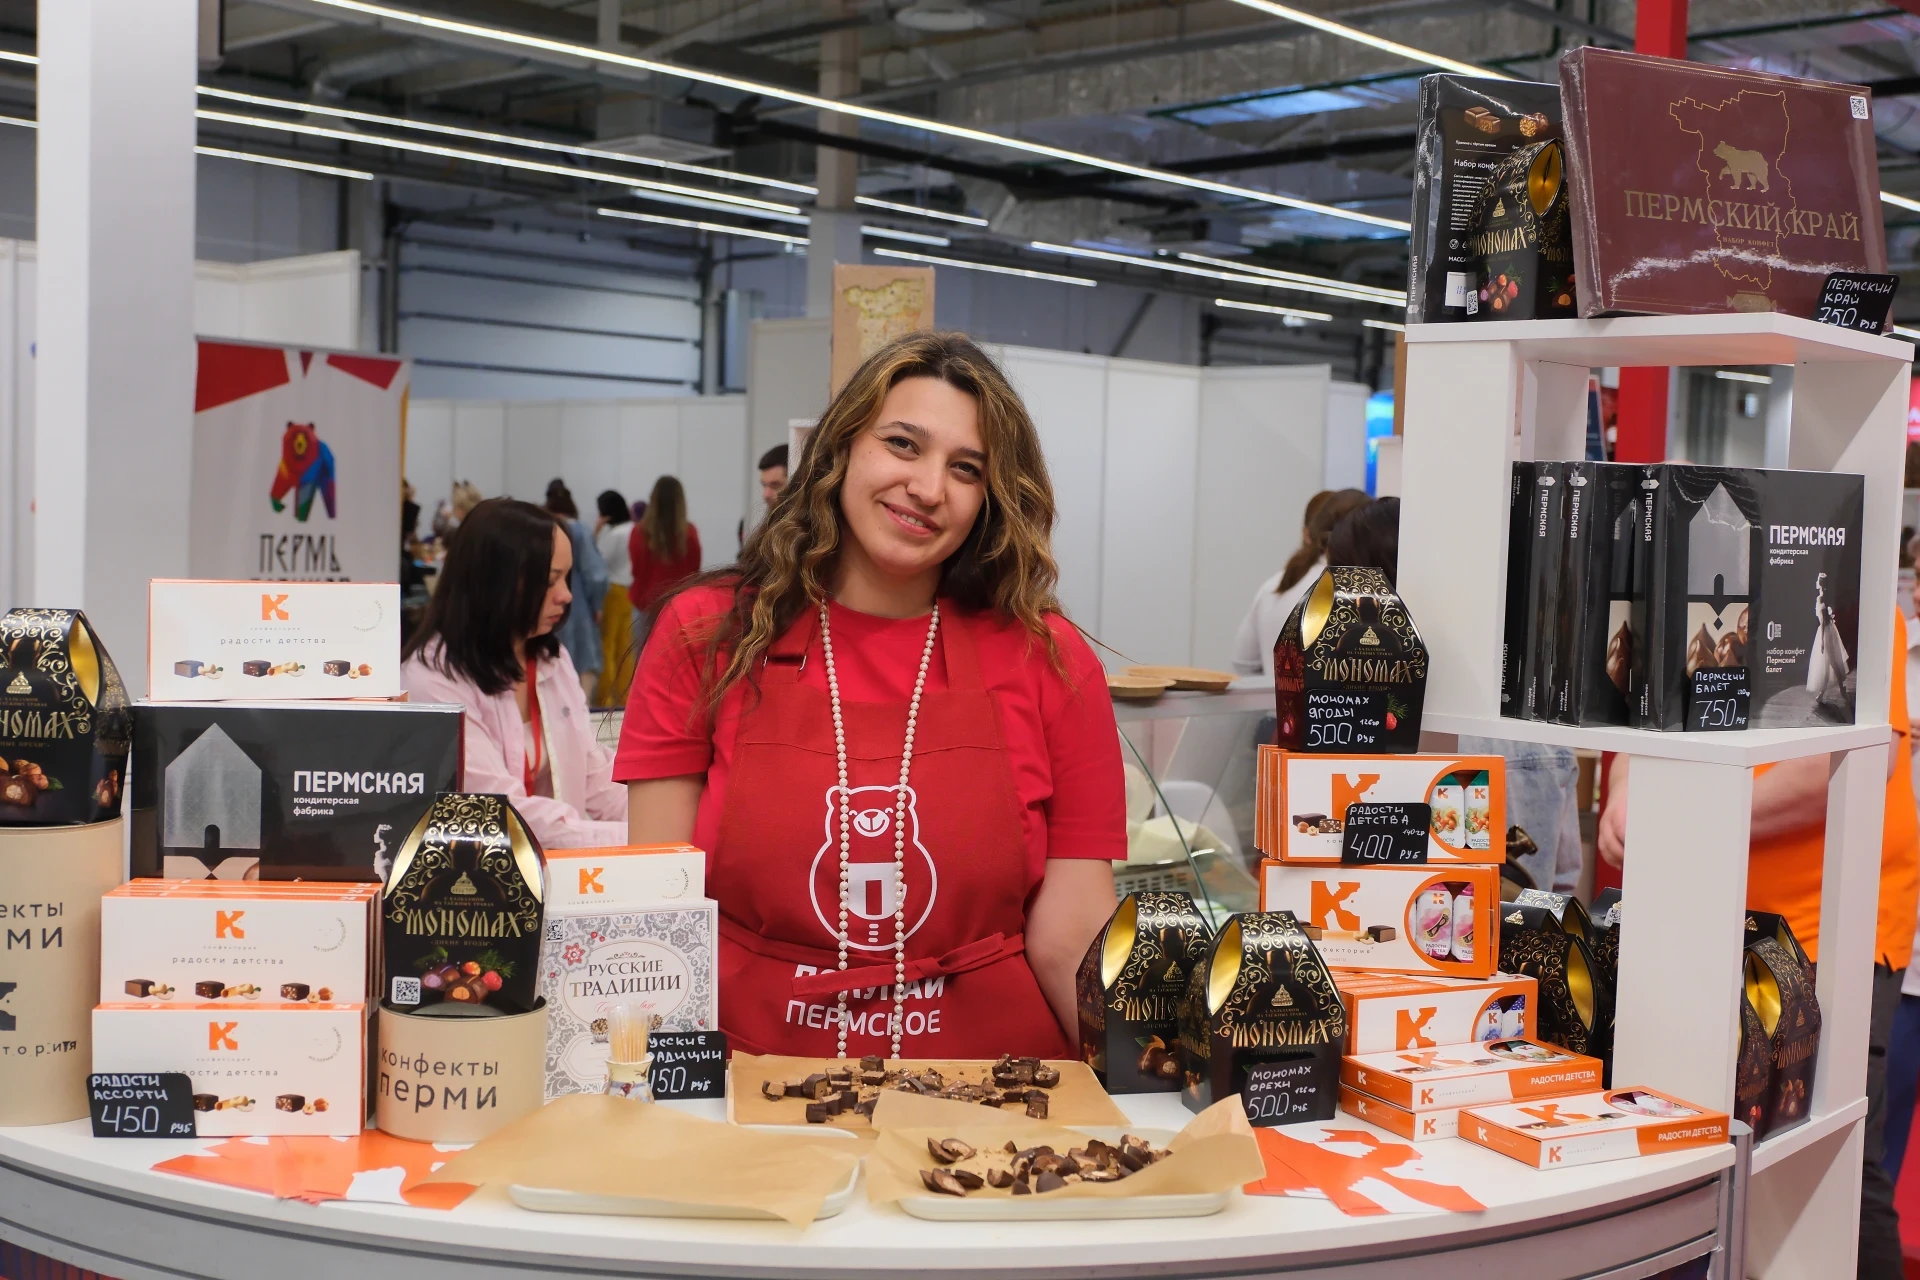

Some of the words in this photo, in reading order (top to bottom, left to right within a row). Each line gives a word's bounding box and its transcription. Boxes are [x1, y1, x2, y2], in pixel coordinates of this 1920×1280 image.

[1454, 158, 1476, 169] Набор
[1624, 190, 1782, 233] ПЕРМСКИЙ
[1792, 209, 1861, 242] КРАЙ
[1722, 236, 1745, 246] НАБОР
[1748, 238, 1775, 248] КОНФЕТ
[1410, 256, 1418, 302] ПЕРМСКАЯ
[1827, 277, 1895, 295] ПЕРМСКИЙ
[1824, 293, 1860, 304] КРАЙ
[1818, 307, 1858, 327] 750
[1539, 490, 1548, 537] ПЕРМСКАЯ
[1570, 490, 1580, 538] ПЕРМСКАЯ
[1644, 493, 1652, 542] ПЕРМСКАЯ
[1770, 525, 1846, 546] ПЕРМСКАЯ
[260, 533, 341, 572] ПЕРМЬ
[1770, 548, 1808, 556] кондитерская
[1770, 557, 1794, 565] фабрика
[220, 638, 271, 646] радости
[1766, 647, 1784, 656] набор
[1784, 648, 1806, 656] конфет
[1766, 656, 1796, 665] Пермский
[1323, 657, 1413, 684] МОНОМАХ
[1696, 683, 1730, 694] БАЛЕТ
[1308, 694, 1370, 705] МОНОМАХ
[1308, 708, 1354, 720] ЯГОДЫ
[1696, 698, 1736, 728] 750
[0, 710, 74, 738] НОМАХ
[1308, 722, 1352, 746] 500
[1357, 734, 1376, 744] РУБ
[294, 770, 424, 794] ПЕРМСКАЯ
[294, 796, 359, 806] кондитерская
[294, 806, 334, 817] фабрика
[1350, 806, 1404, 816] РАДОСТИ
[1348, 814, 1409, 826] ДЕТСТВА
[1350, 833, 1394, 860] 400
[1400, 850, 1421, 860] РУБ
[0, 902, 63, 918] екты
[406, 908, 522, 938] МОНОМАХ
[172, 956, 226, 965] радости
[232, 956, 284, 965] детства
[588, 960, 663, 977] РУССКИЕ
[569, 974, 682, 998] ТРАДИЦИИ
[1125, 995, 1178, 1021] МОНО
[786, 1000, 941, 1036] ПЕРМСКОЕ
[1232, 1019, 1330, 1049] МОНОМАХ
[381, 1048, 498, 1078] конфекты
[648, 1050, 722, 1063] АДИЦИИ
[92, 1075, 160, 1088] РАДОСТИ
[1252, 1066, 1312, 1081] МОНОМАХ
[1530, 1074, 1564, 1086] РАДОСТИ
[1565, 1070, 1596, 1082] ДЕТСТВА
[1250, 1080, 1291, 1092] ОРЕХИ
[94, 1090, 168, 1101] АССОРТИ
[1249, 1092, 1290, 1121] 500
[100, 1106, 160, 1134] 450
[170, 1122, 193, 1134] РУБ
[1658, 1130, 1691, 1142] РАДОСТИ
[1691, 1125, 1723, 1138] ДЕТСТВА
